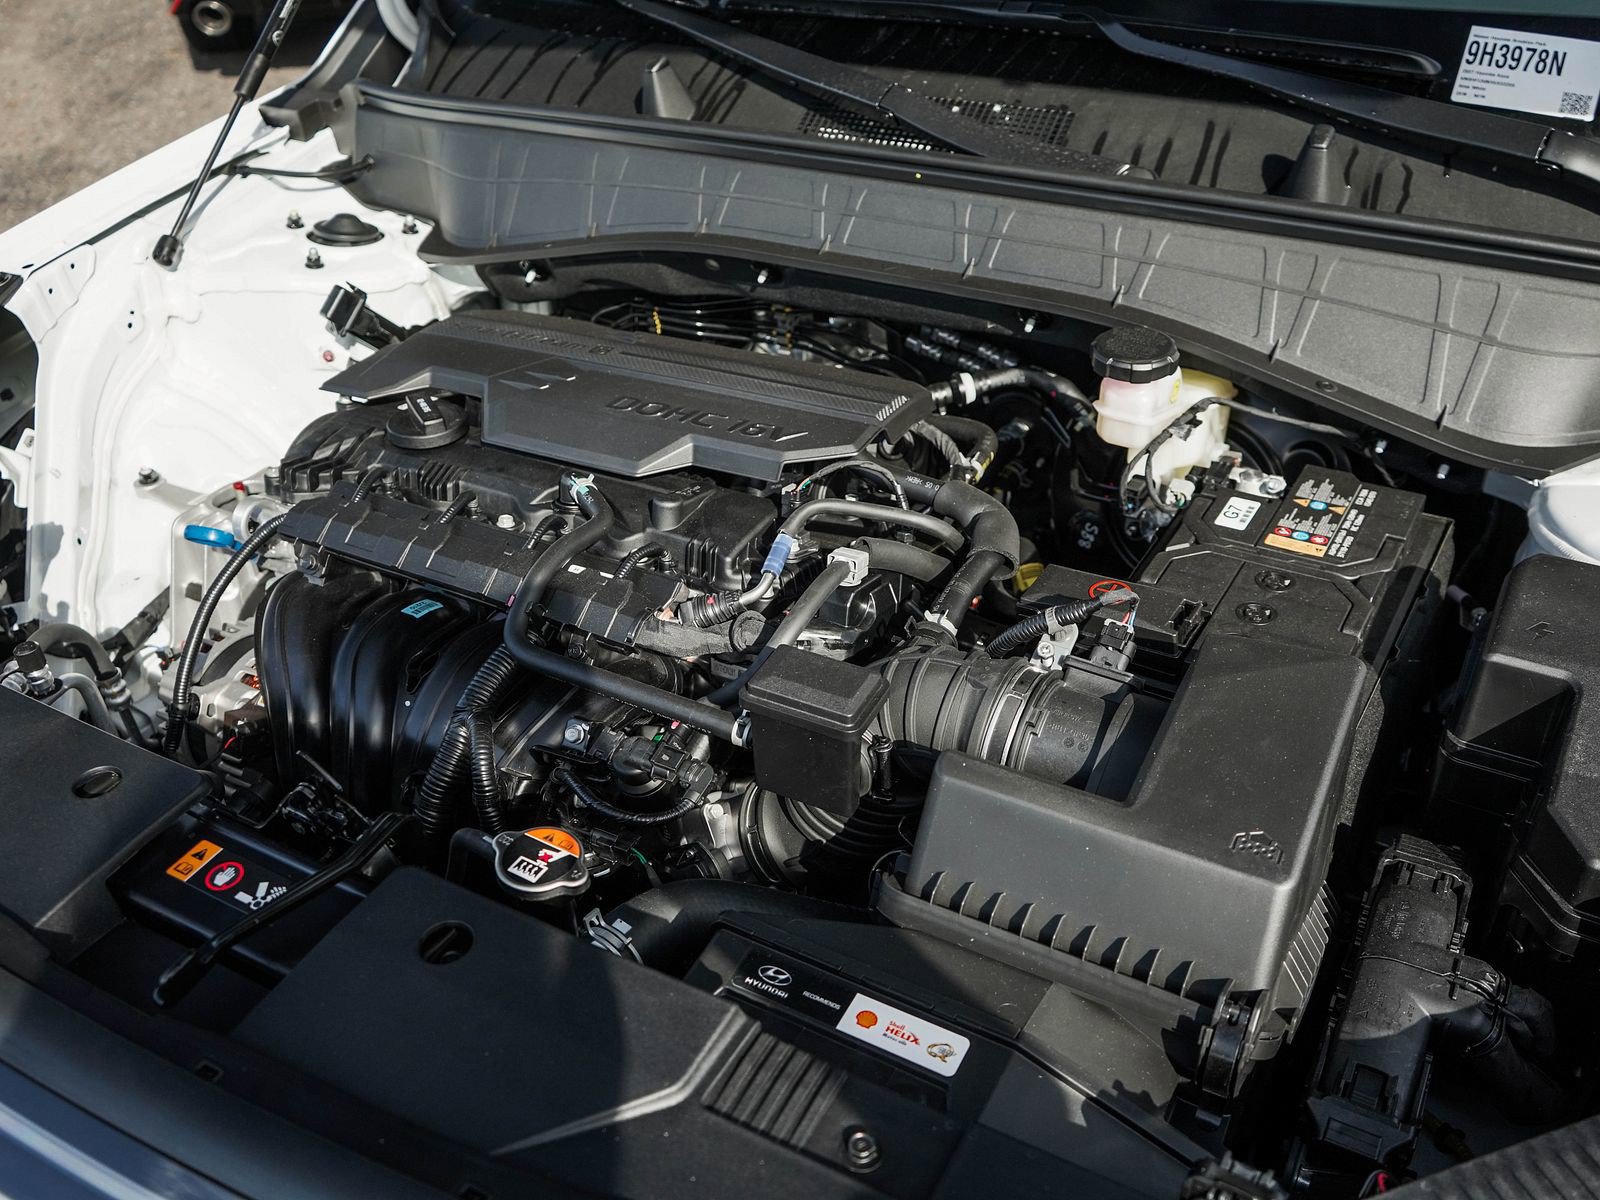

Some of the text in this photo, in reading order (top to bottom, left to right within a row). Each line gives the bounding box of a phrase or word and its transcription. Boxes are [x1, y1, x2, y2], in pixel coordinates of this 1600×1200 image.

[1465, 40, 1567, 77] 9H3978N
[606, 396, 809, 442] DOHC 16V
[1223, 504, 1242, 519] G7
[744, 976, 789, 999] HYUNDAI
[802, 990, 841, 1010] RECOMMENDS
[889, 1020, 906, 1031] Shell
[885, 1026, 920, 1046] HELIX
